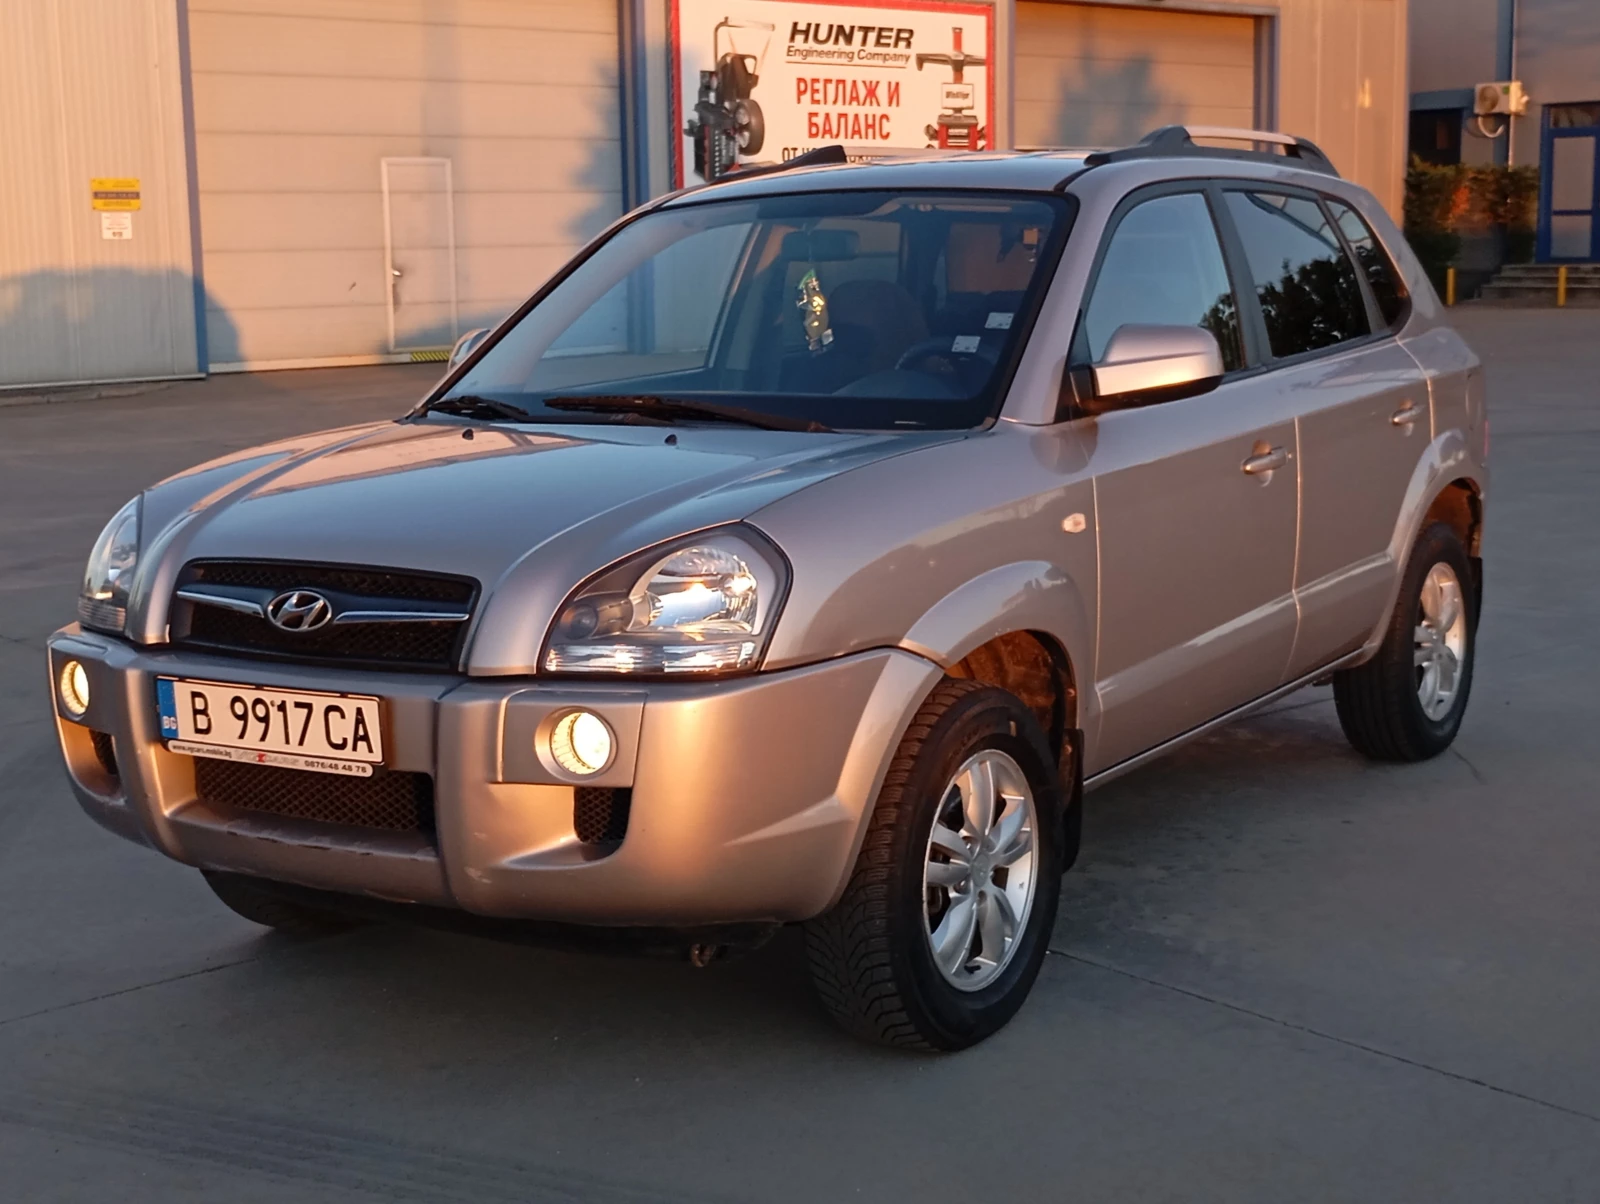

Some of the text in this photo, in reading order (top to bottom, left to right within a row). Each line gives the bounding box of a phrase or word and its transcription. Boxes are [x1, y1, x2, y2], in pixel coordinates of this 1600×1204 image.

[788, 21, 914, 49] HUNTER
[786, 45, 912, 65] Engineering Company
[796, 77, 900, 107] РЕГЛАЖ И
[807, 111, 891, 140] БАЛАНС
[162, 715, 178, 730] BG
[190, 690, 375, 754] B 9917 CA
